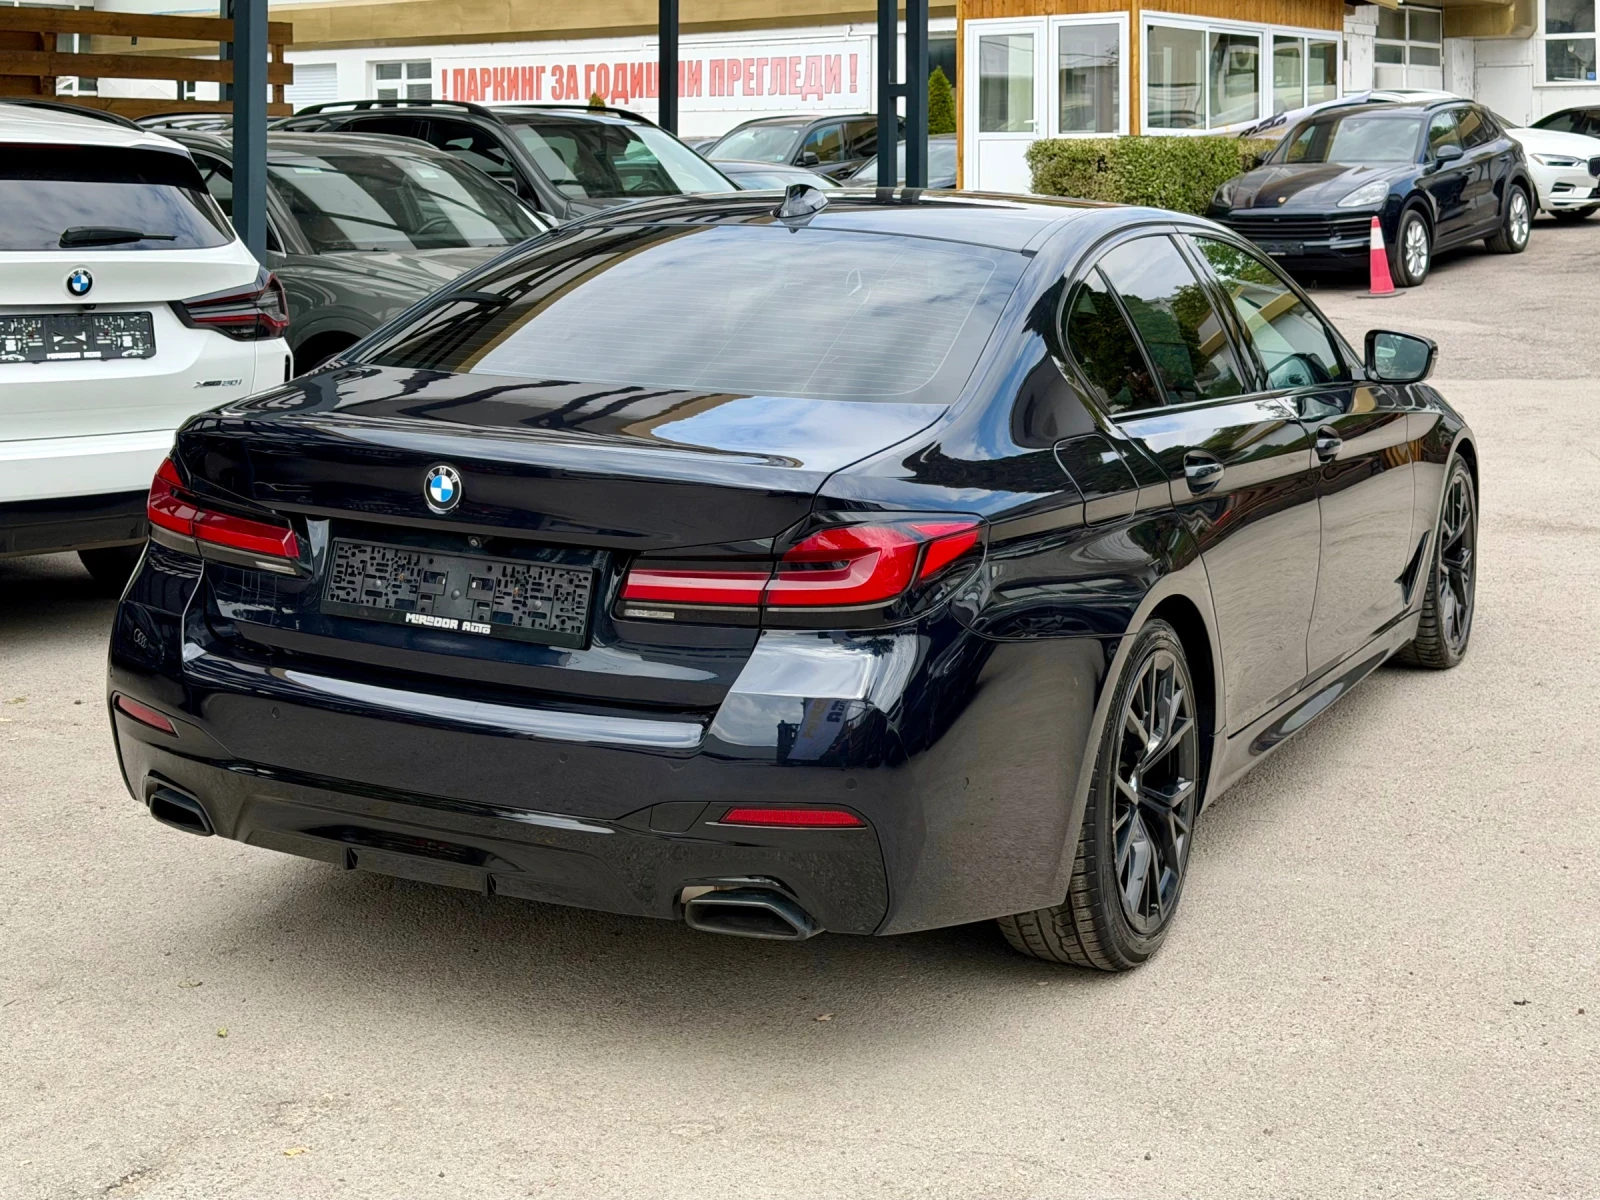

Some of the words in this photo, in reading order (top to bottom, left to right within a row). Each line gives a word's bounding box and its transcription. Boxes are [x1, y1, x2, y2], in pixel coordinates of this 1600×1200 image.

[453, 66, 546, 102] ПАРКИНГ
[551, 64, 579, 100] ЗА
[709, 54, 842, 101] ПРЕГЛЕДИ
[428, 467, 458, 483] BMW
